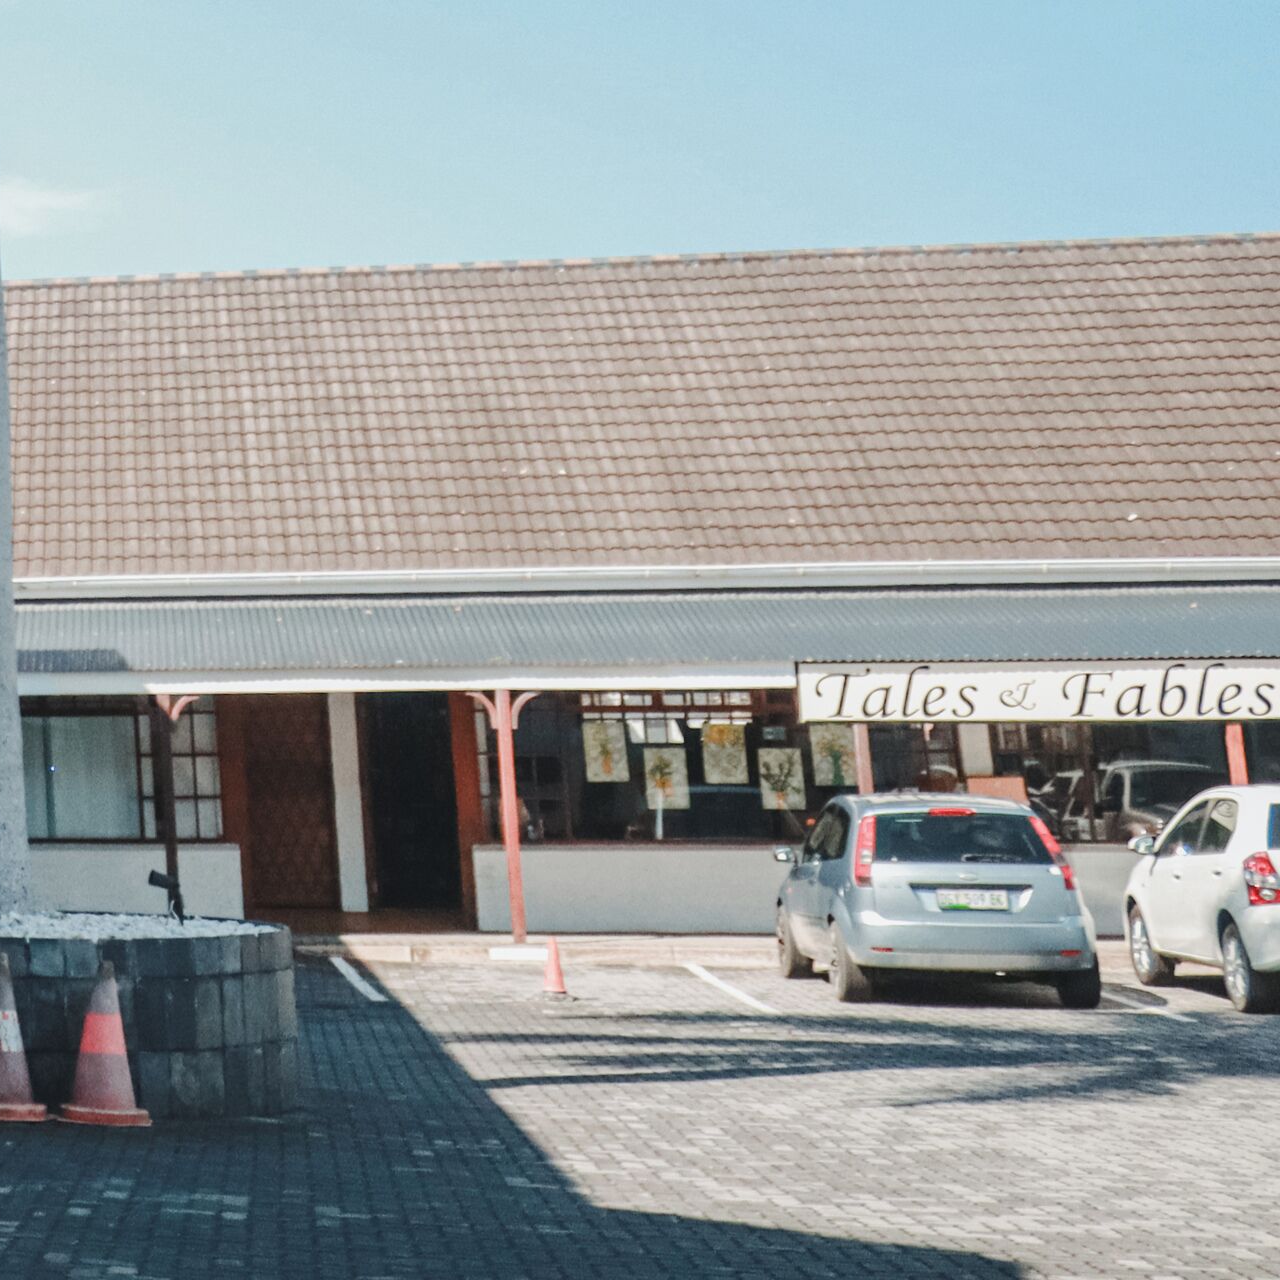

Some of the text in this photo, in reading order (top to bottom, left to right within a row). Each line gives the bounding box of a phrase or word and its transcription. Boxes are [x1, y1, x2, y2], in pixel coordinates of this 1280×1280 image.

[816, 663, 1275, 718] Tales & Fables
